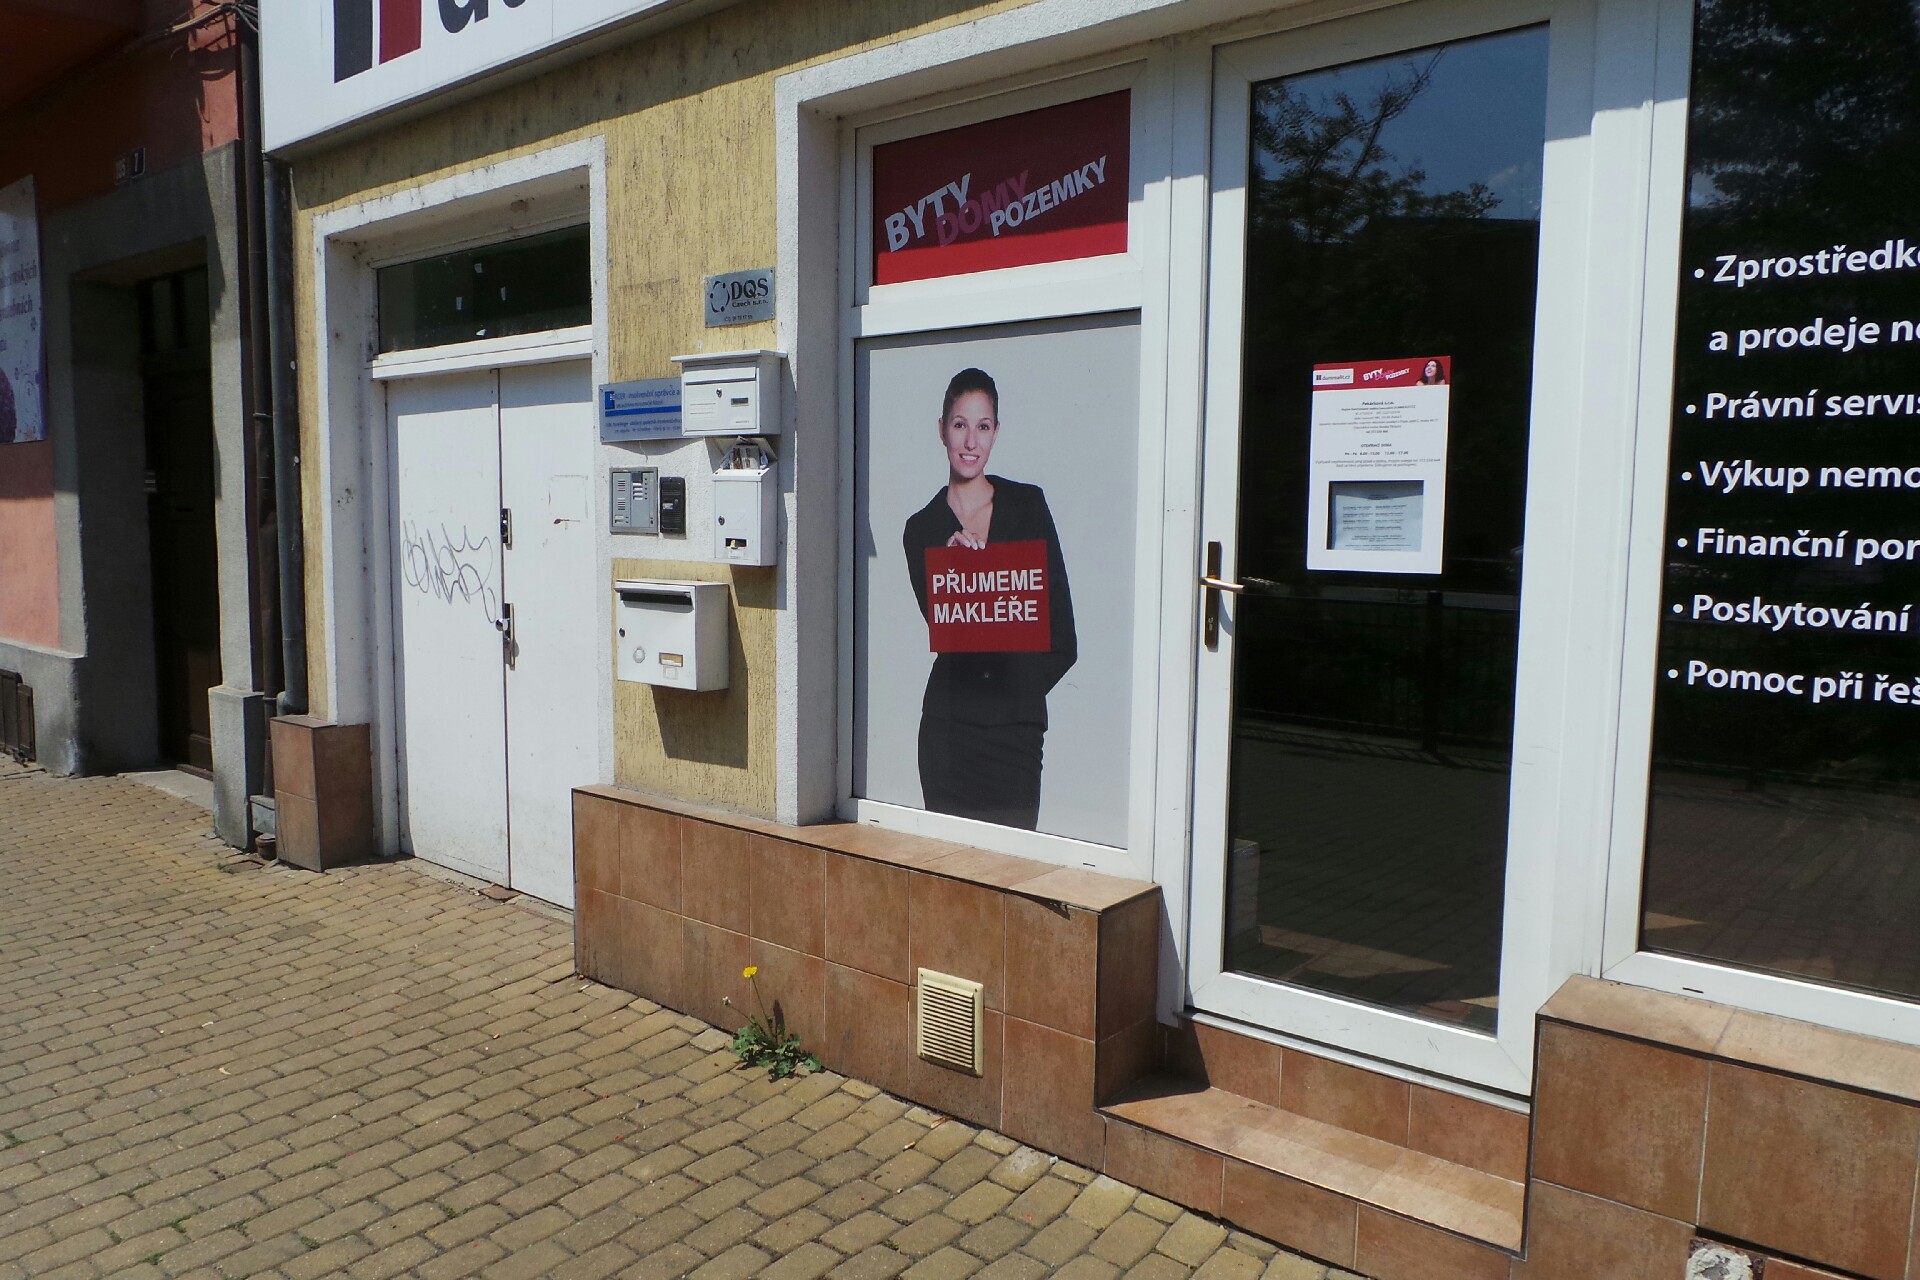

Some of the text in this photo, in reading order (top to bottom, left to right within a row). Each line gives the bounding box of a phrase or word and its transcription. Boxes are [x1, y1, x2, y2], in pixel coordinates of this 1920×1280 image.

[884, 172, 971, 252] BYTY
[935, 170, 1029, 247] DOMY
[990, 155, 1107, 236] POZEMKY
[1713, 239, 1920, 288] Zprostředk
[730, 277, 769, 300] DQS
[732, 300, 751, 308] Czech
[1708, 317, 1920, 356] a prodeje n
[1363, 368, 1383, 381] BYTY
[1705, 388, 1920, 419] Právní servi
[1700, 460, 1920, 493] Výkup nemo
[1697, 528, 1849, 558] Finanční
[932, 568, 1043, 594] PŘIJMEME
[933, 595, 1039, 624] MAKLÉŘE
[1692, 594, 1914, 632] Poskytování
[1687, 660, 1804, 695] Pomoc
[1812, 671, 1864, 703] při
